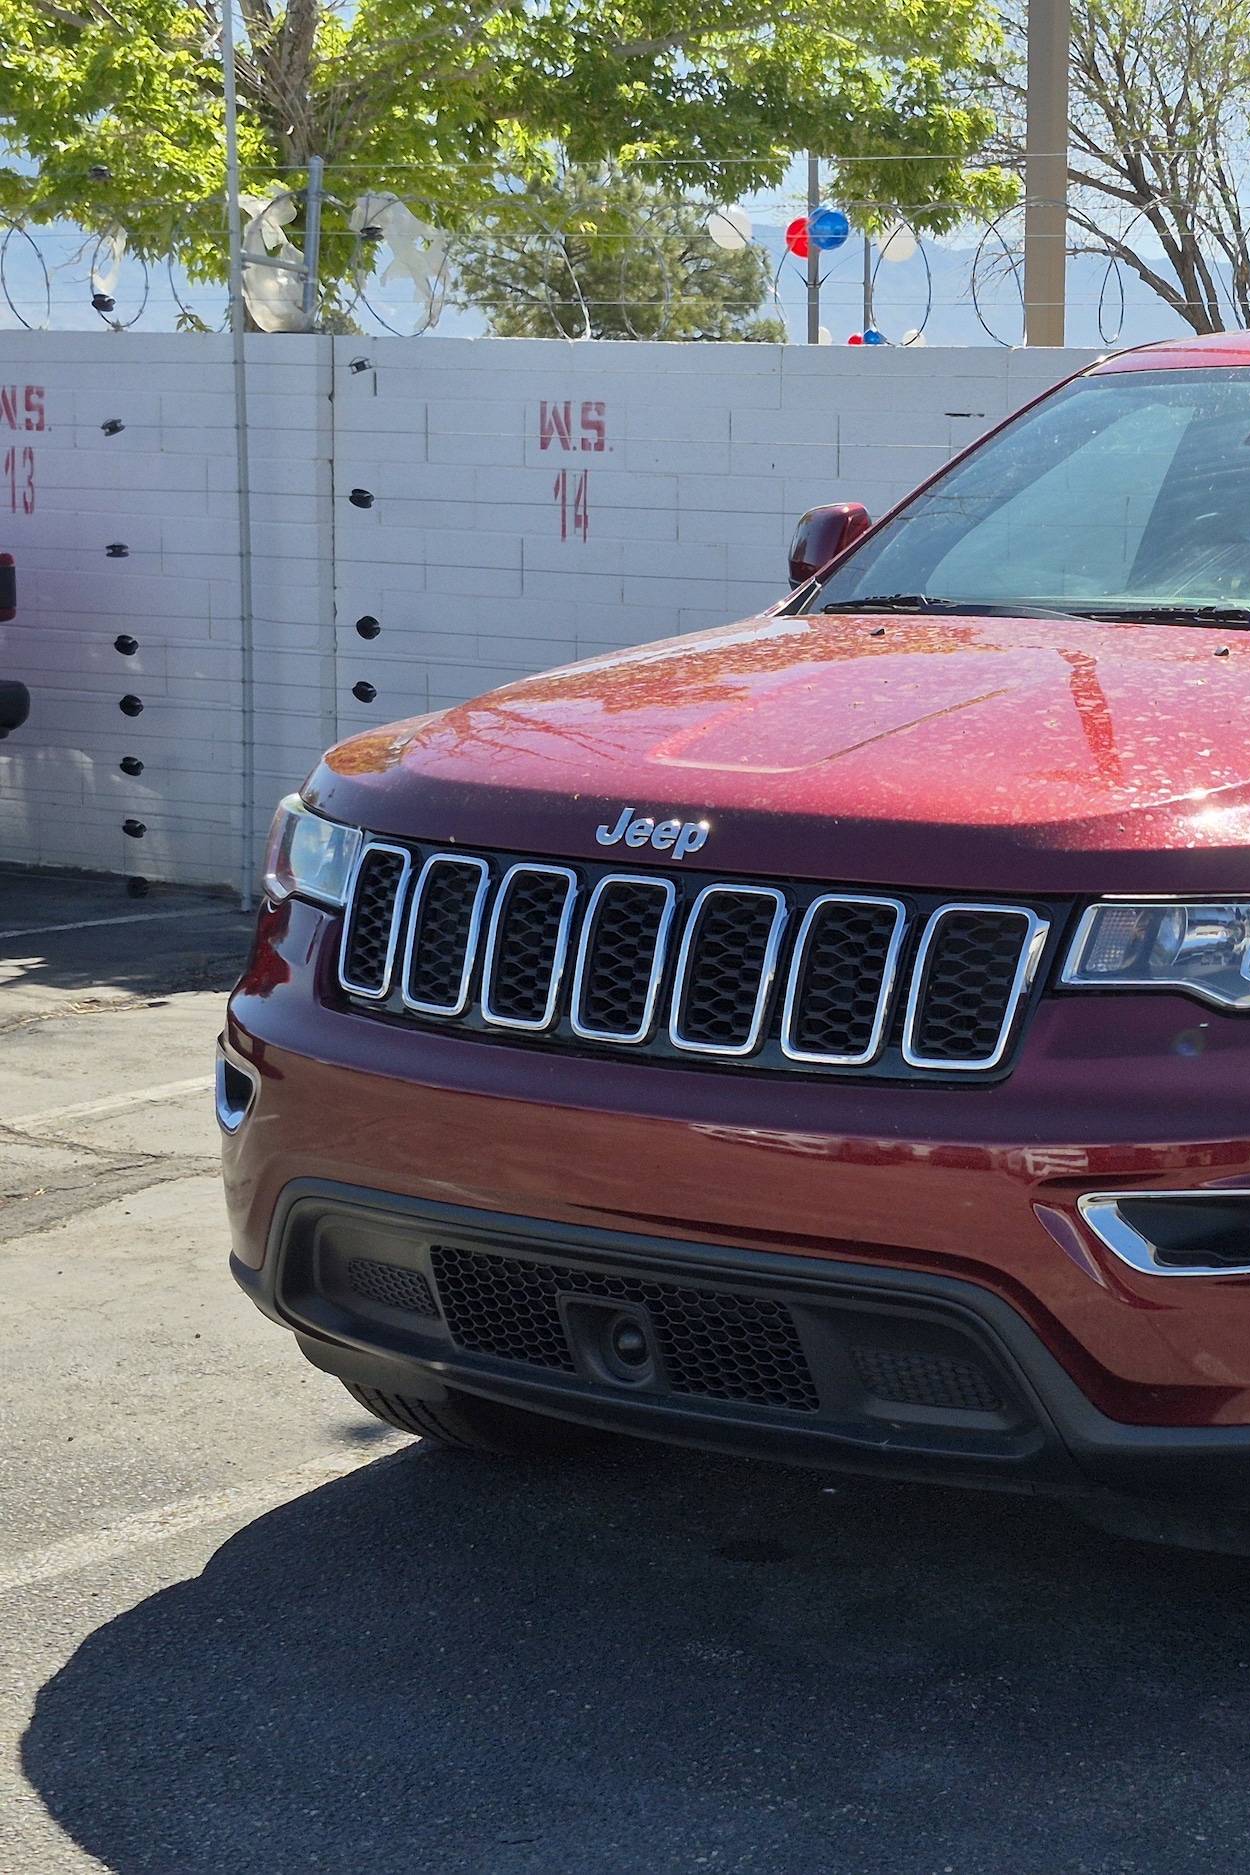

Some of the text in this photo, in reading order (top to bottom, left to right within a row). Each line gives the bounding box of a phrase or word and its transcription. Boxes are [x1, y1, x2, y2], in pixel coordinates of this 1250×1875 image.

[539, 400, 614, 452] W.S.
[4, 445, 35, 515] 13
[553, 468, 589, 544] 14
[595, 807, 710, 860] Jeep
